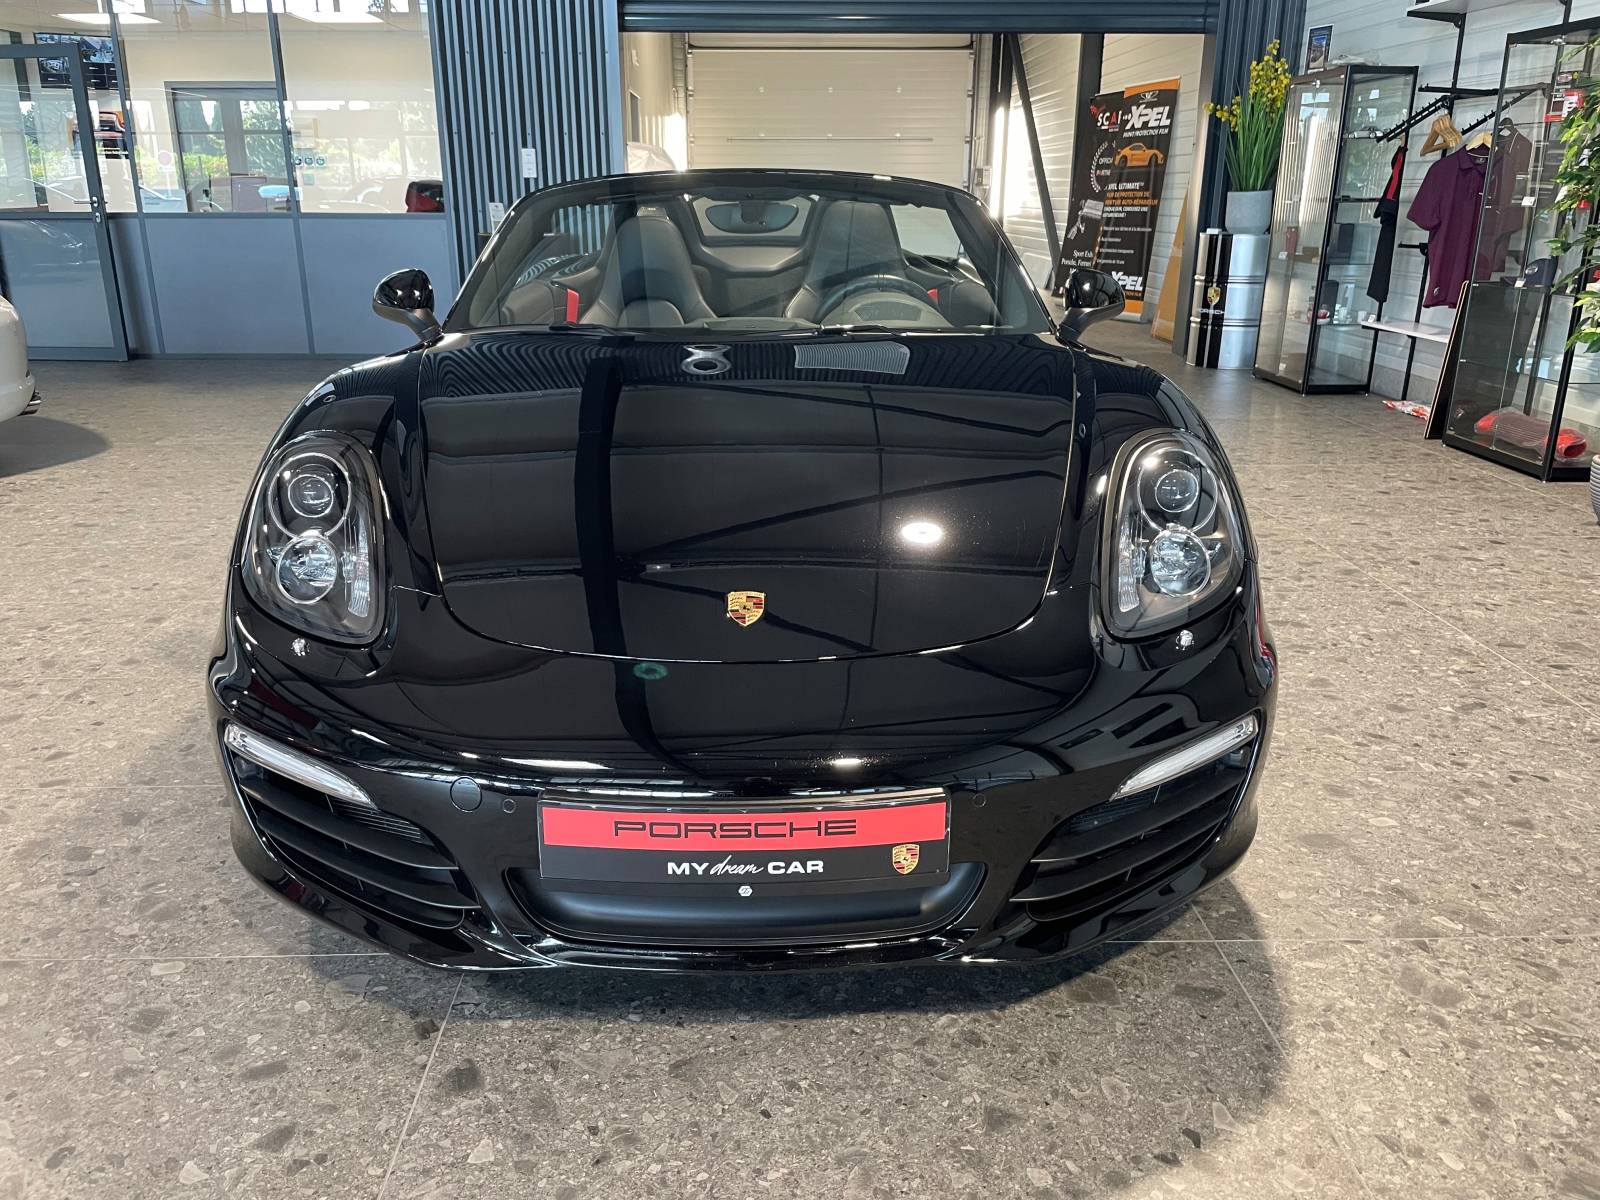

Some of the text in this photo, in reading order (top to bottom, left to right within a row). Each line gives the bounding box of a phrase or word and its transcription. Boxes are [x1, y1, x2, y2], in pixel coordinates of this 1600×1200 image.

[1125, 104, 1171, 130] XPEL
[613, 818, 857, 839] PORSCHE
[667, 854, 825, 876] MY dream CAR
